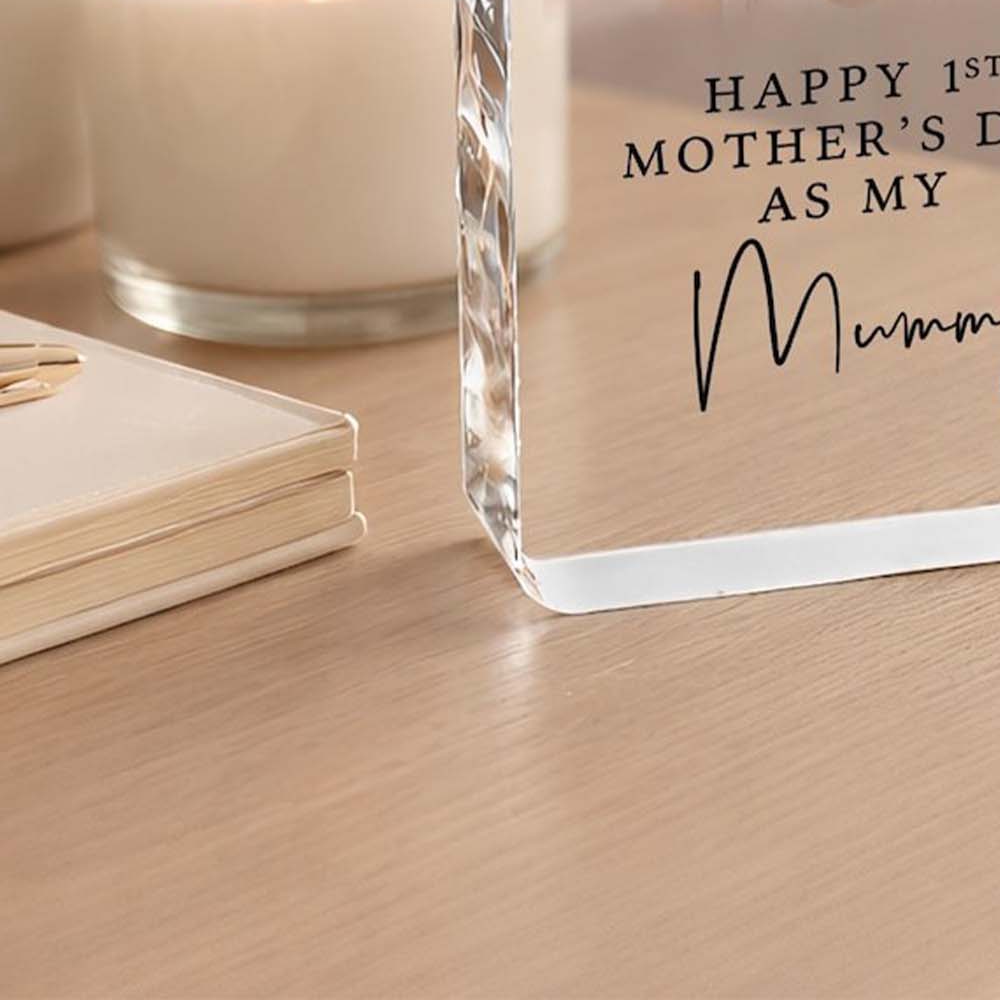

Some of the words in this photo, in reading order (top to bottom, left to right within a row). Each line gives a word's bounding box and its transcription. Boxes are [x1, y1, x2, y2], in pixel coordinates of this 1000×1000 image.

[704, 61, 910, 114] HAPPY
[622, 114, 946, 179] MOTHER’S
[757, 182, 831, 224] AS
[861, 171, 947, 214] MY
